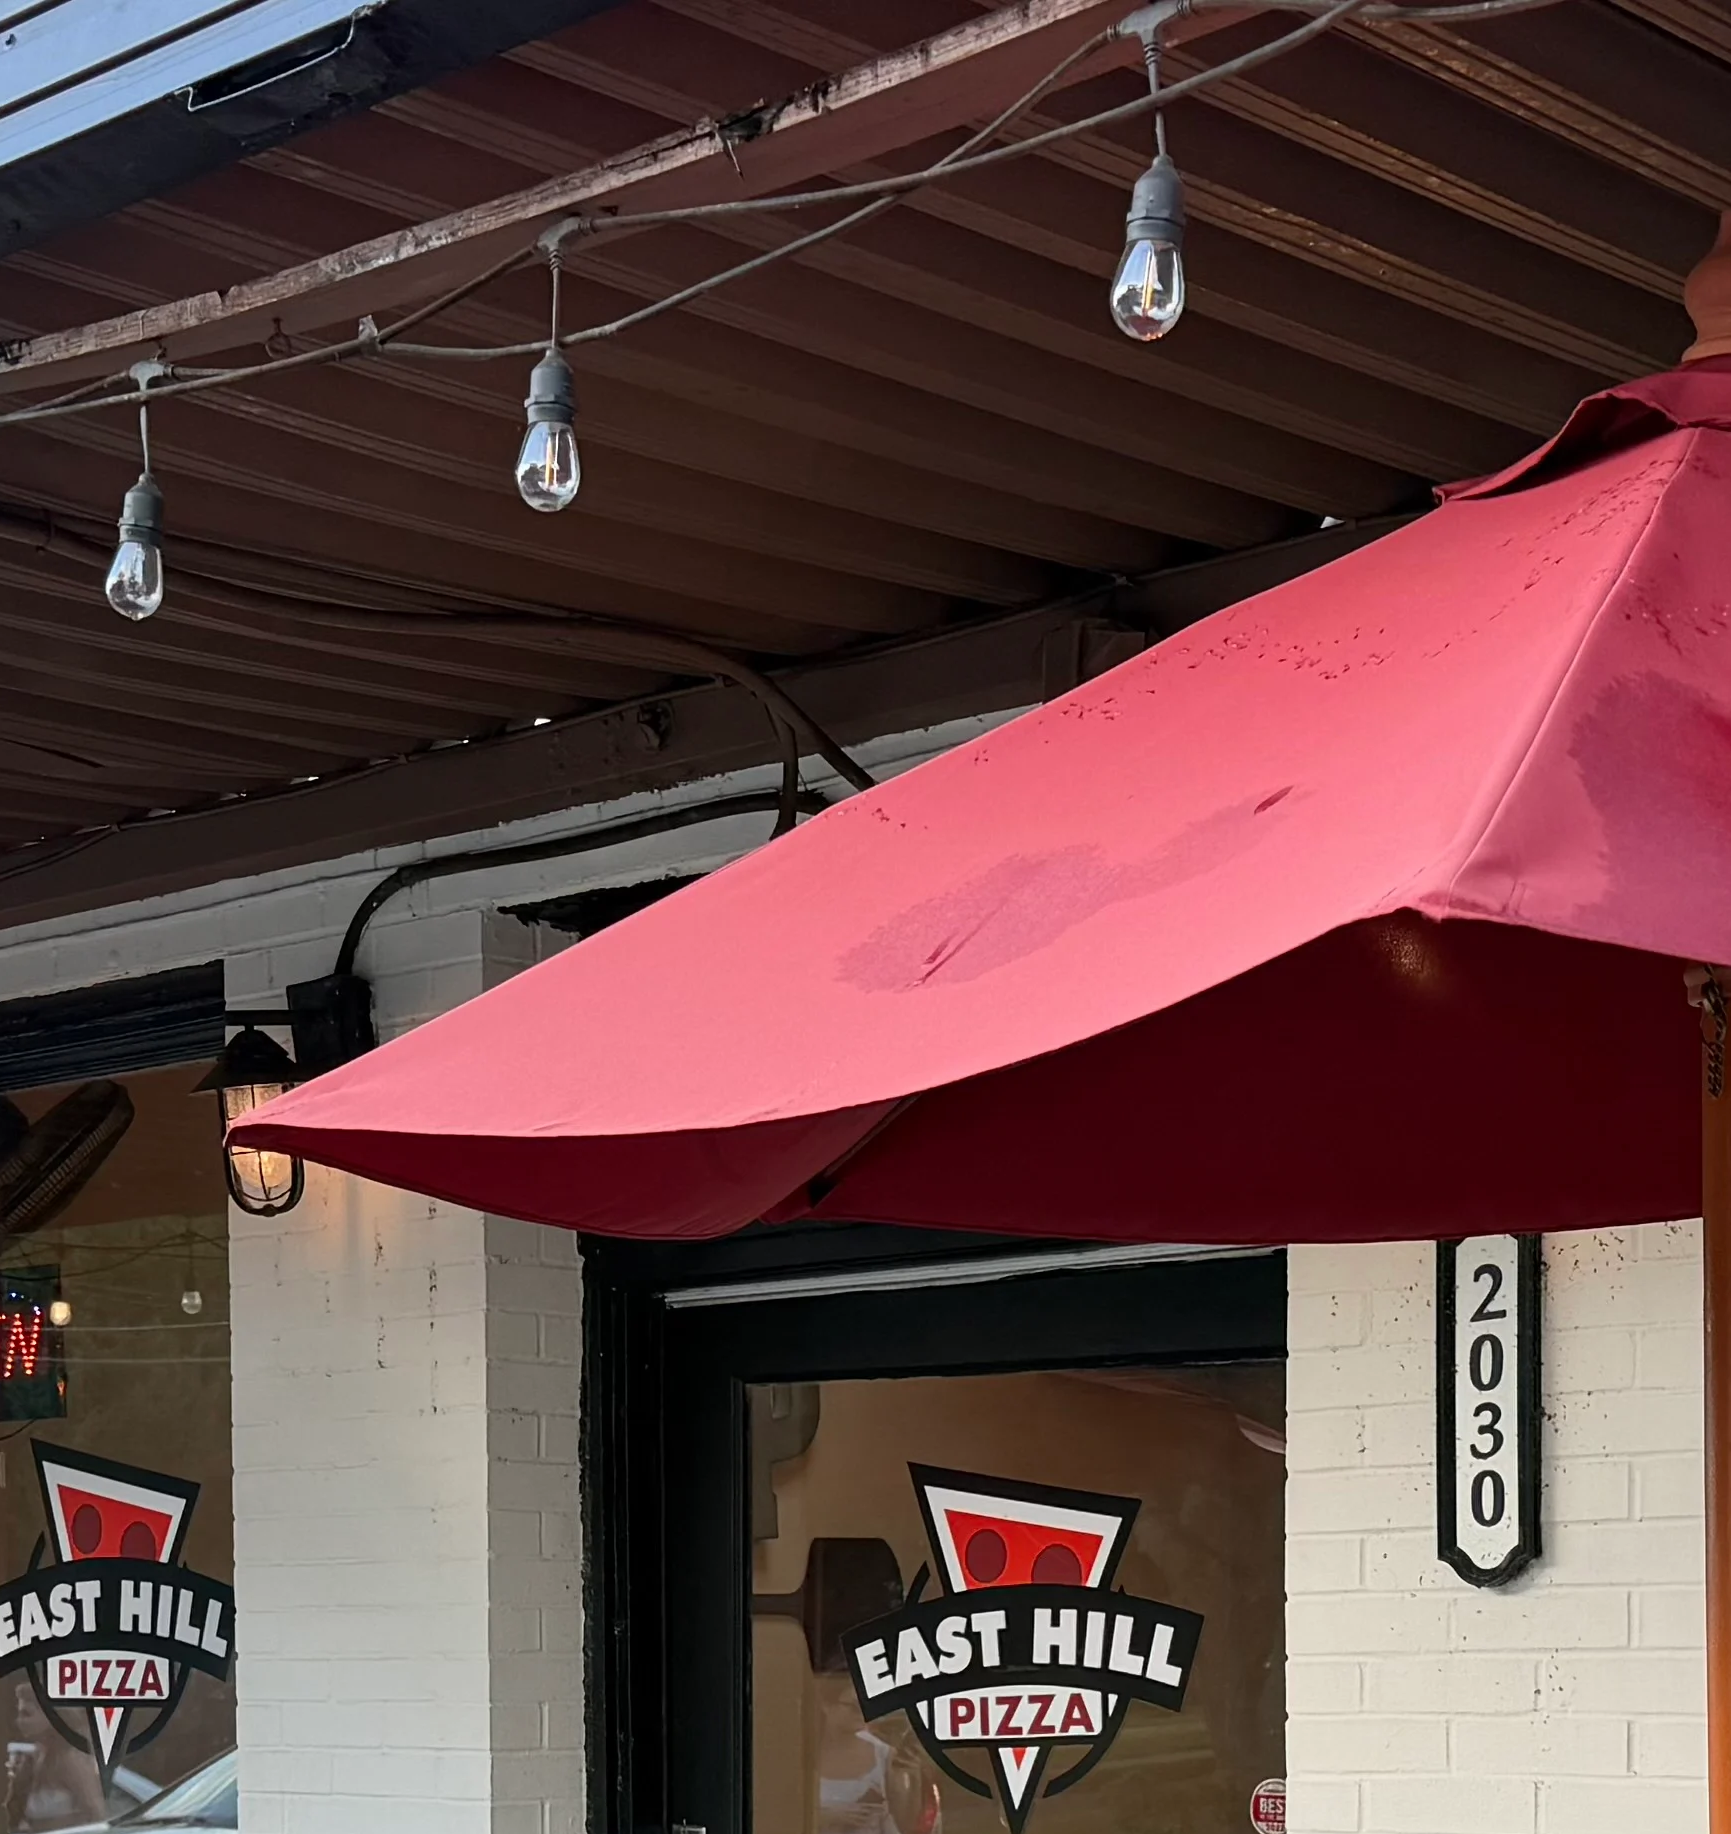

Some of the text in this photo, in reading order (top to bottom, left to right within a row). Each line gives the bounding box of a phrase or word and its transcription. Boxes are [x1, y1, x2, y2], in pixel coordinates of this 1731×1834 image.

[1469, 1263, 1507, 1528] 2030
[118, 1579, 229, 1659] HILL
[57, 1659, 165, 1698] PIZZA
[854, 1608, 1183, 1699] EAST HILL
[949, 1694, 1095, 1736] PIZZA
[1260, 1798, 1285, 1813] BES
